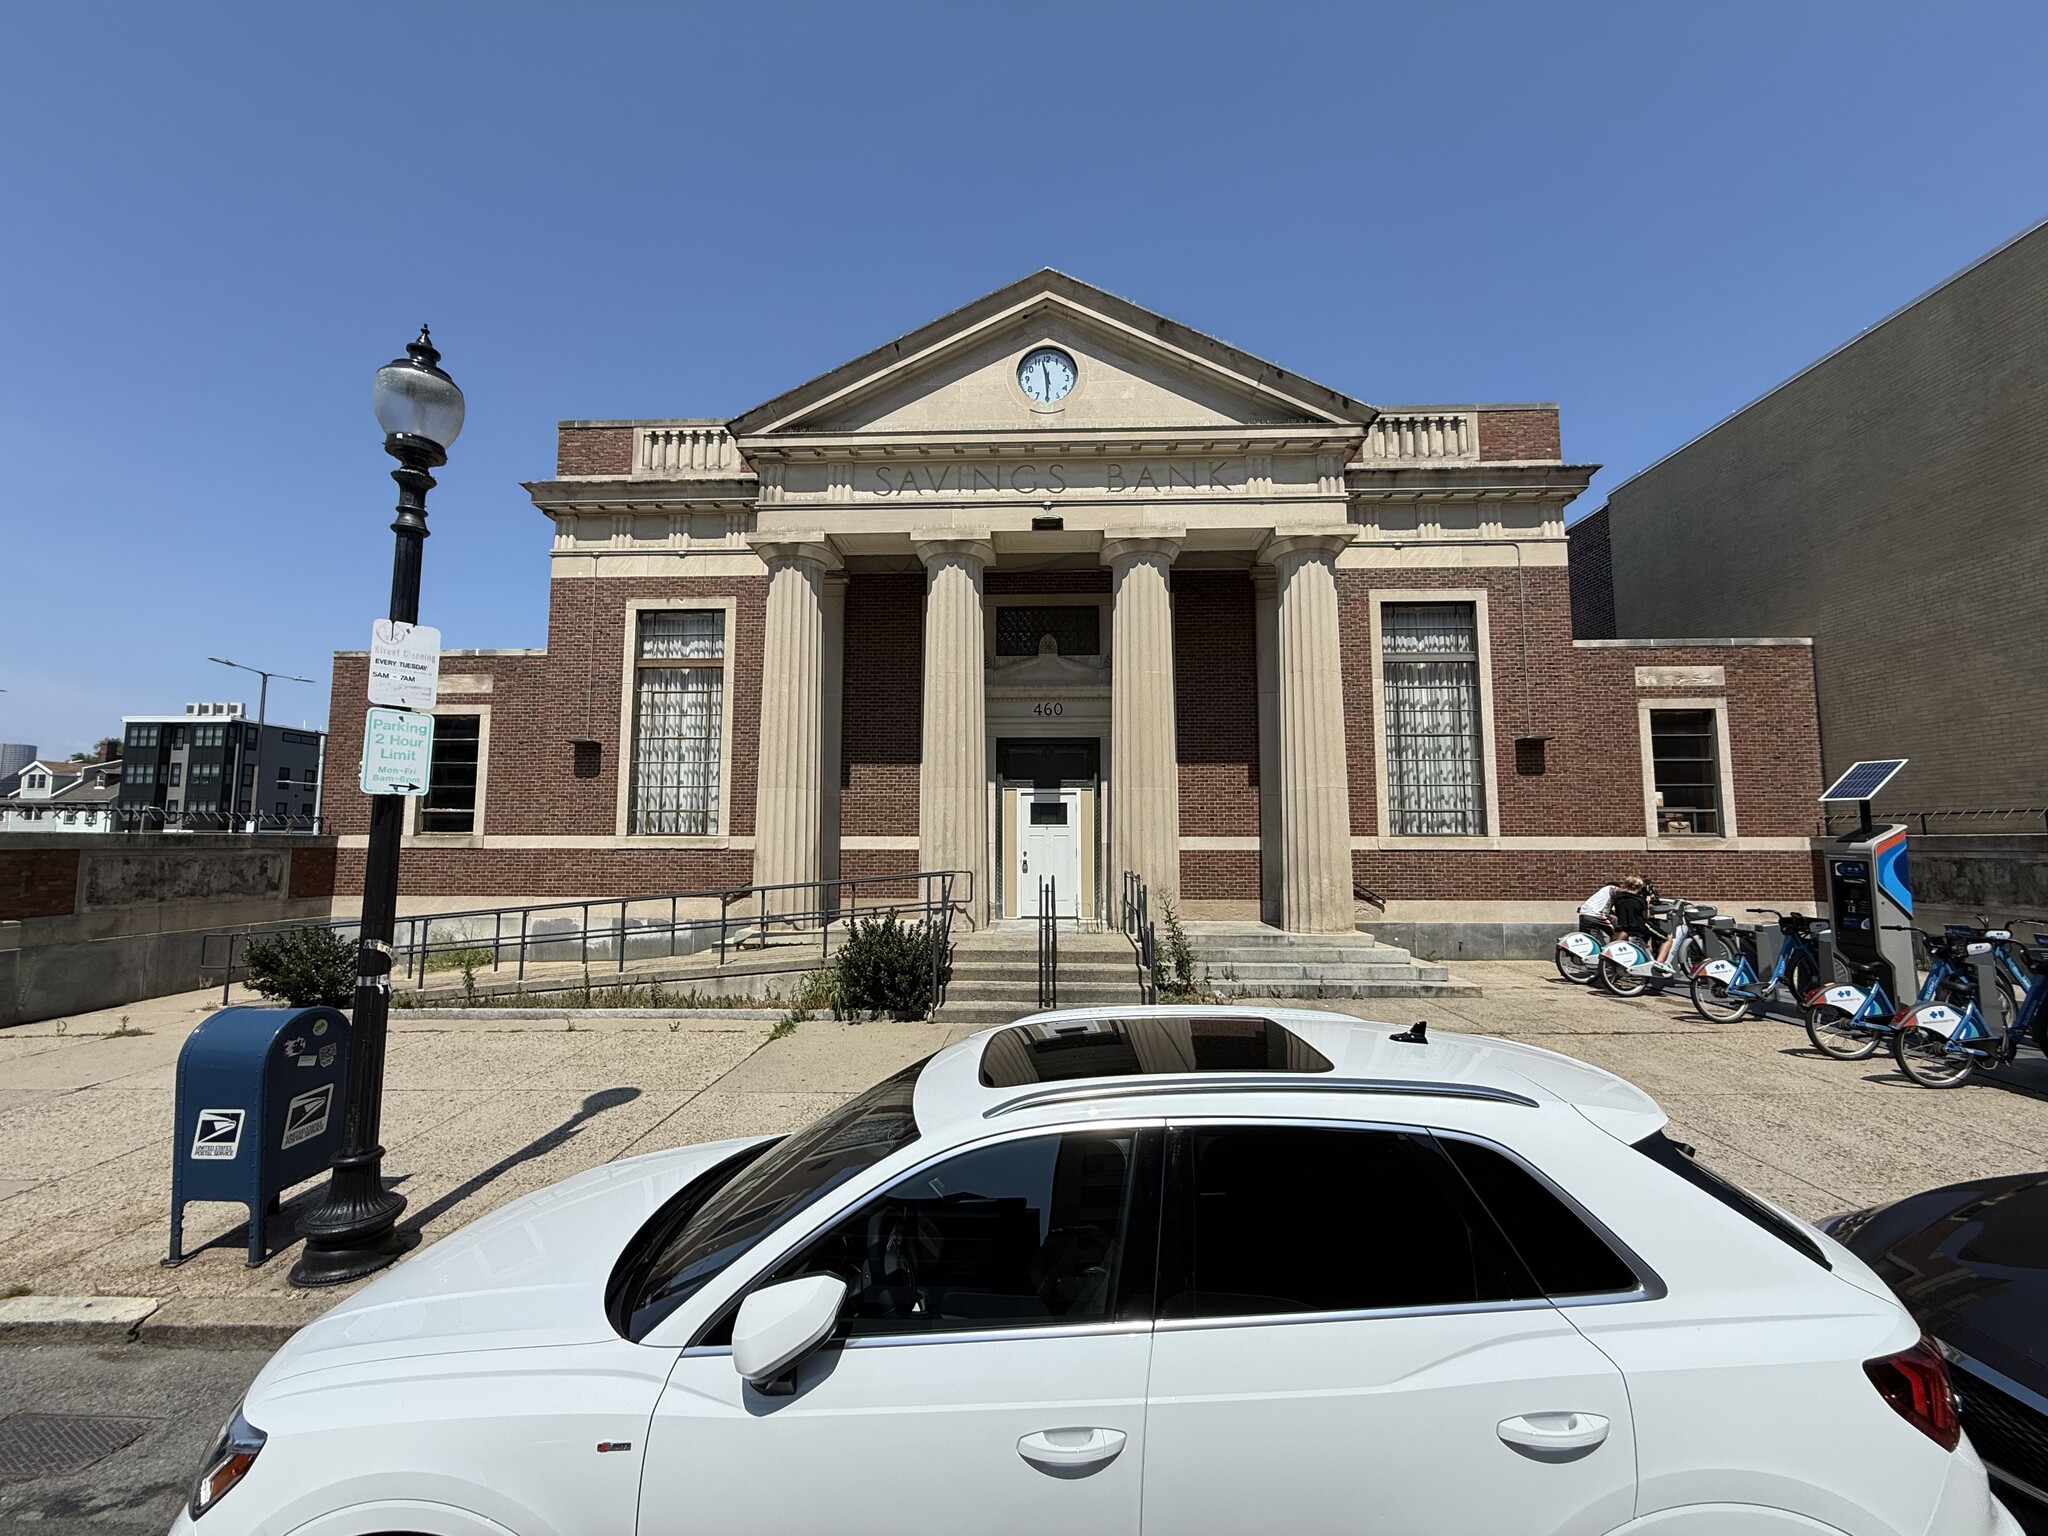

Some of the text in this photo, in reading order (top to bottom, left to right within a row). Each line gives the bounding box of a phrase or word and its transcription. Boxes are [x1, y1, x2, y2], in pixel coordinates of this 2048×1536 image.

[1035, 392, 1040, 400] 7
[872, 460, 1233, 497] SAVINGS BANK
[374, 645, 400, 656] Street
[375, 658, 428, 671] EVERY TUESDAY
[372, 671, 389, 679] 5AM
[1033, 702, 1063, 716] 460
[373, 718, 428, 736] Parking
[375, 733, 423, 748] 2 Hour
[380, 748, 416, 761] Limit
[378, 766, 417, 775] Mon-Fri
[372, 774, 420, 784] 8am-6pm
